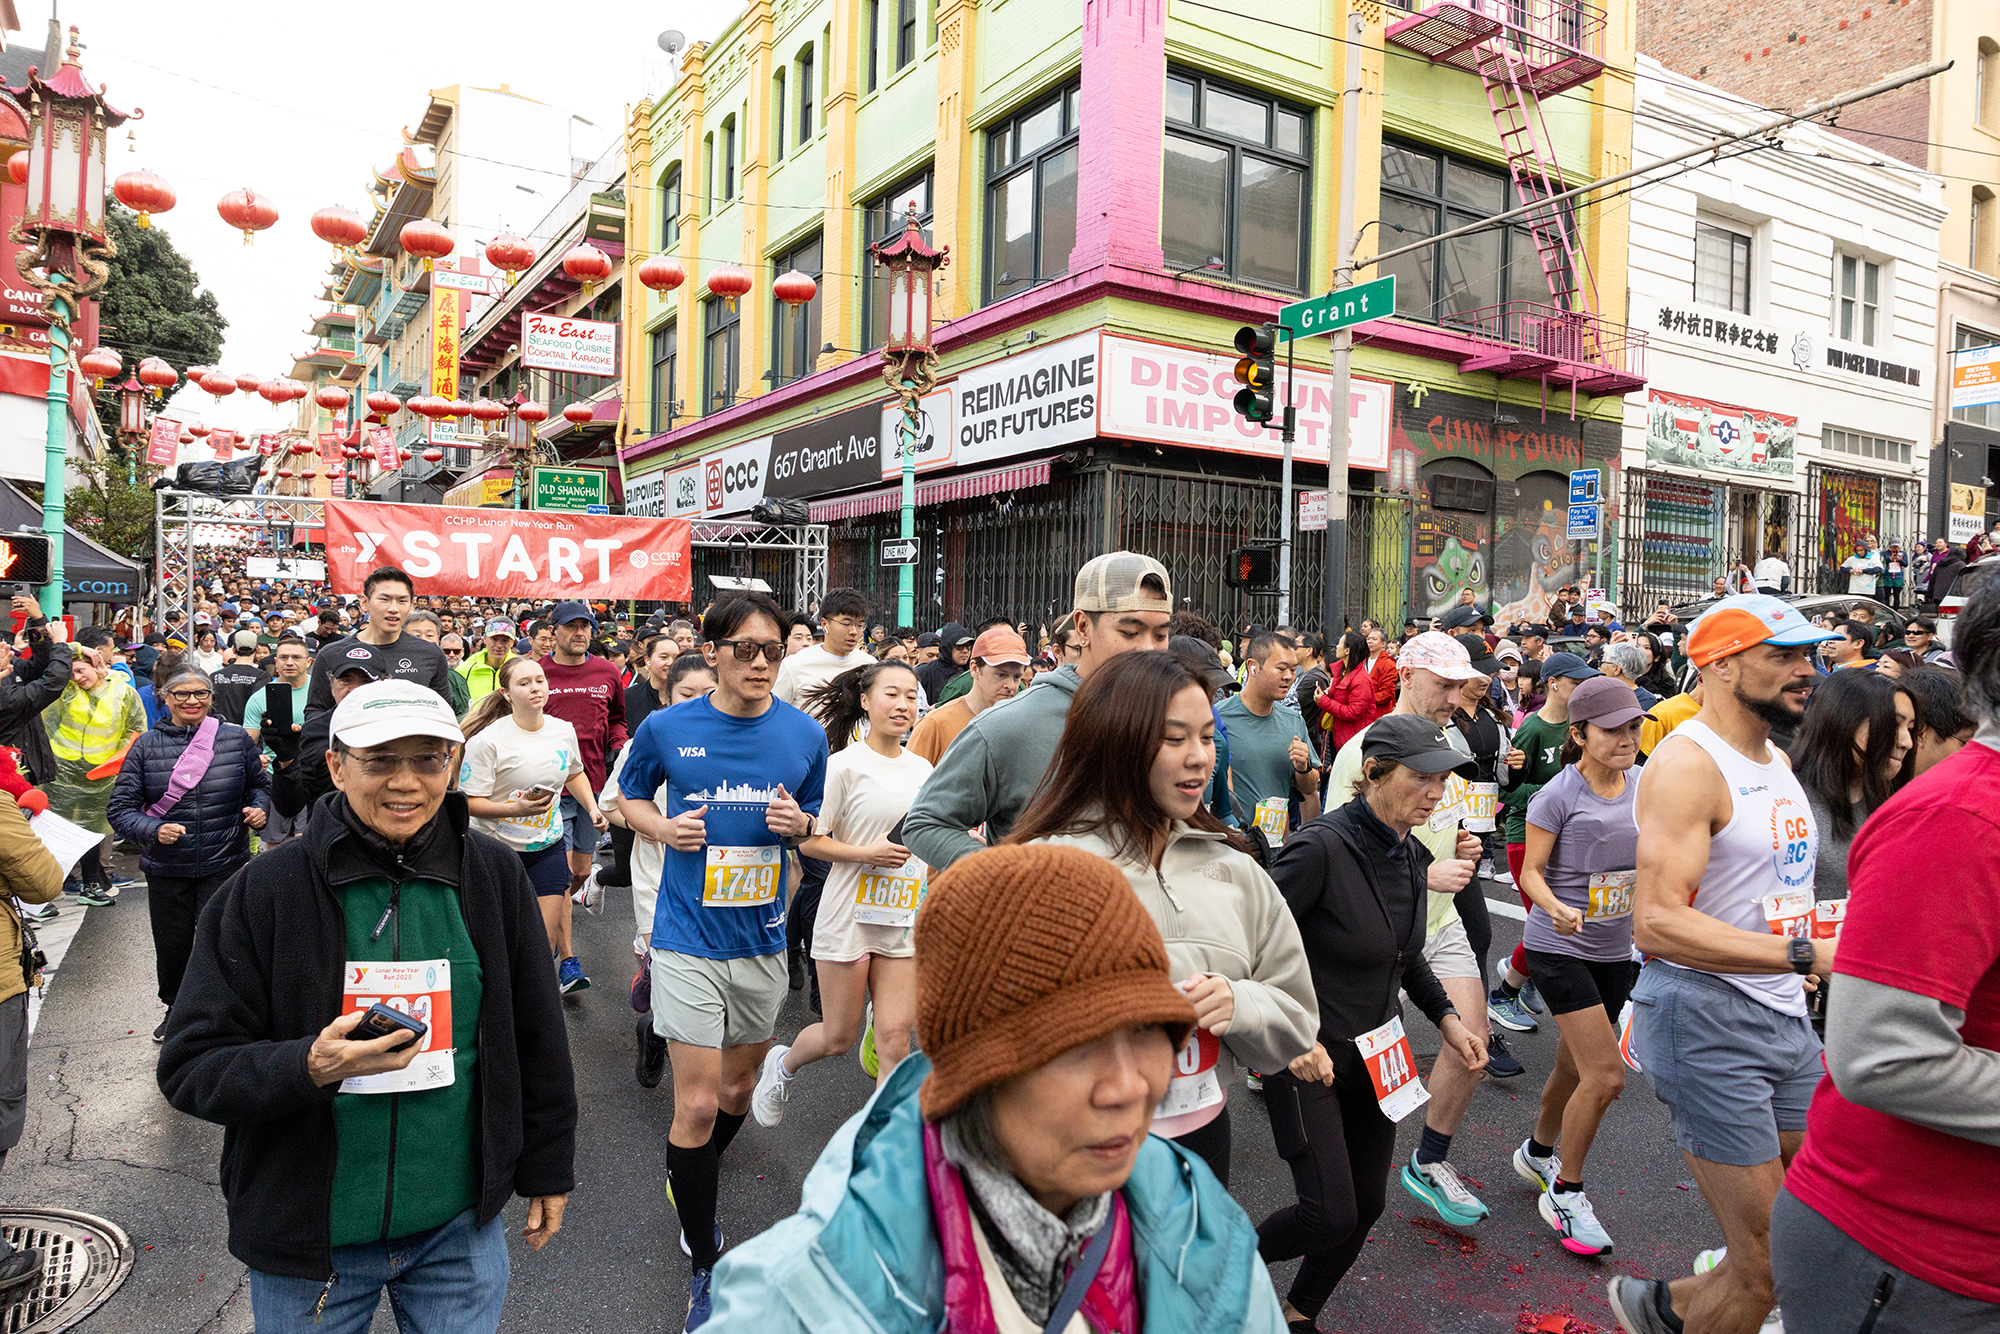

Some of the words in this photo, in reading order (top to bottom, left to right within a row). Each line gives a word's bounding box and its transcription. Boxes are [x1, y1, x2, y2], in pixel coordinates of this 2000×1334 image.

[4, 289, 44, 303] CANT
[10, 304, 47, 318] BAZA
[1302, 293, 1368, 328] Grant
[528, 317, 556, 334] Far
[558, 322, 595, 340] East
[437, 293, 455, 401] 康年海鮮酒
[1971, 350, 1989, 358] TCP
[1958, 375, 1997, 386] AVAILABLE
[1964, 371, 1991, 379] SPACES
[1966, 365, 1991, 373] RETAIL
[962, 354, 1094, 417] REIMAGINE
[1131, 356, 1367, 418] DISCUNT
[960, 420, 997, 446] OUR
[1001, 394, 1094, 438] FUTURES
[158, 429, 178, 441] 大吉
[1428, 415, 1583, 467] CHINATOWN
[774, 451, 798, 480] 667
[800, 440, 843, 473] Grant
[847, 435, 876, 462] Ave
[484, 480, 499, 488] Sports
[724, 459, 759, 494] CCC
[1572, 474, 1583, 482] Pay
[539, 484, 555, 494] OLD
[557, 485, 599, 497] SHANGHAI
[626, 480, 664, 504] EMPOWER
[445, 515, 475, 525] CCHP
[478, 517, 507, 527] Lunar
[510, 519, 531, 528] New
[532, 521, 554, 530] Year
[556, 521, 575, 531] Run
[340, 545, 357, 553] the
[402, 530, 623, 584] START
[650, 552, 681, 561] CCHP
[885, 547, 896, 558] ONE
[897, 546, 907, 557] WAY
[62, 580, 128, 594] s.com
[548, 687, 562, 695] ack
[677, 747, 706, 757] VISA
[1468, 795, 1497, 818] 1817
[1774, 797, 1792, 807] Gate
[1770, 806, 1780, 851] Golden
[1785, 817, 1808, 841] GG
[1783, 841, 1808, 866] RC
[711, 866, 774, 900] 1749
[1784, 862, 1813, 886] Running
[861, 875, 915, 908] 1665
[1379, 1042, 1410, 1093] 444
